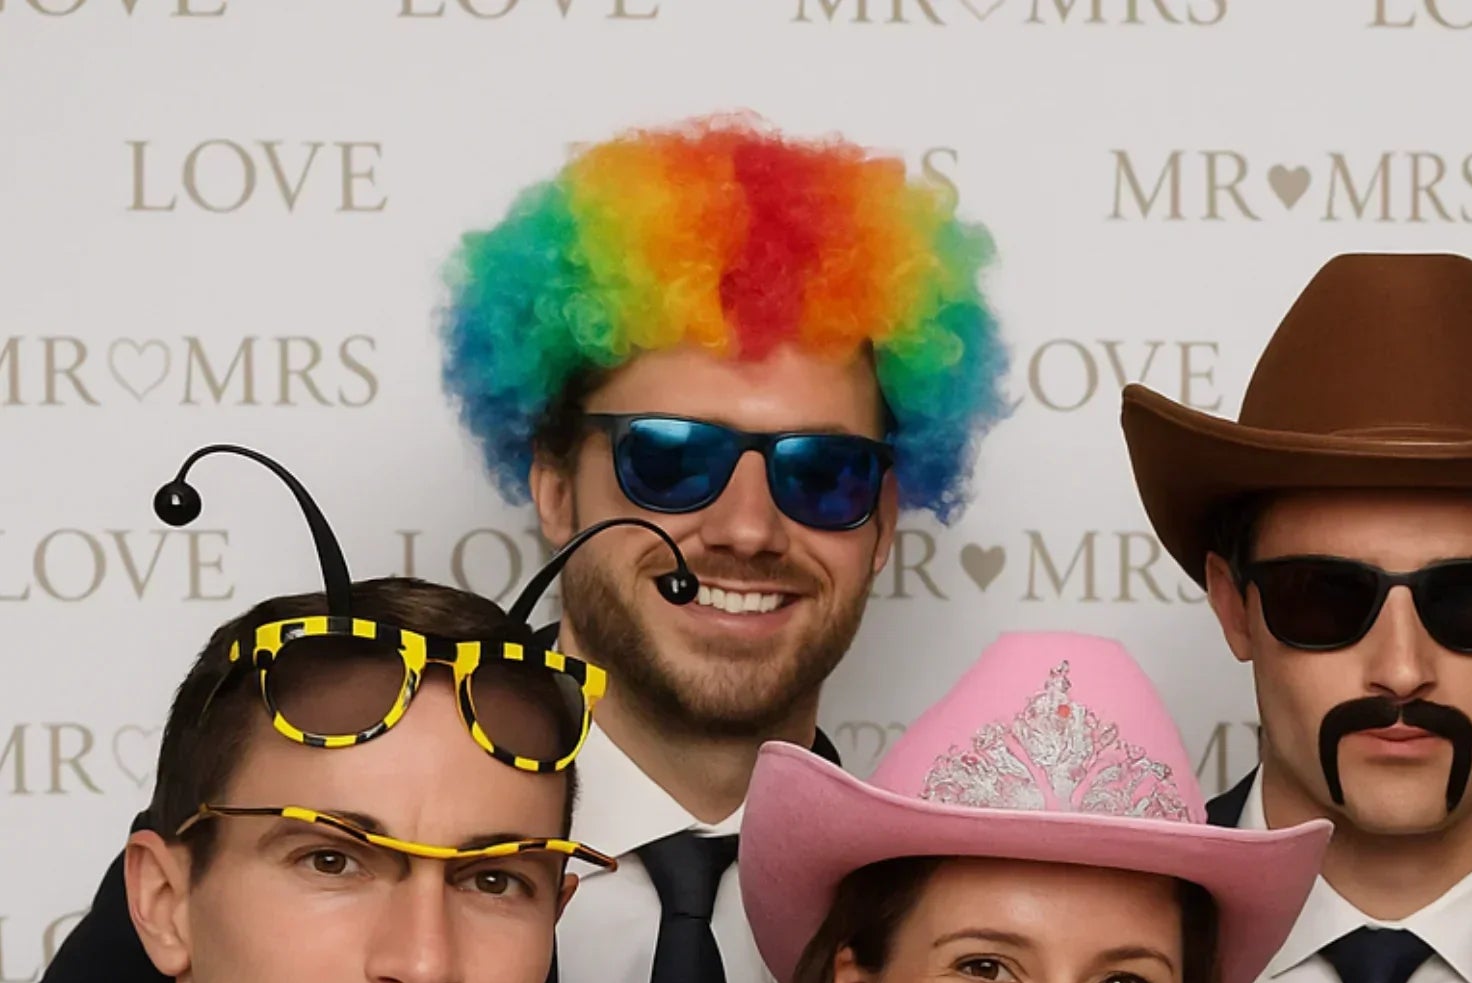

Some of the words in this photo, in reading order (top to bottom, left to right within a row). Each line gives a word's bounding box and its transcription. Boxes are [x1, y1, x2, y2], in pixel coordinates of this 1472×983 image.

[125, 139, 389, 214] LOVE
[1106, 148, 1262, 222] MR
[179, 334, 380, 408] MRS
[1006, 338, 1224, 413] OVE
[870, 529, 949, 600] R
[1022, 529, 1206, 604] MR
